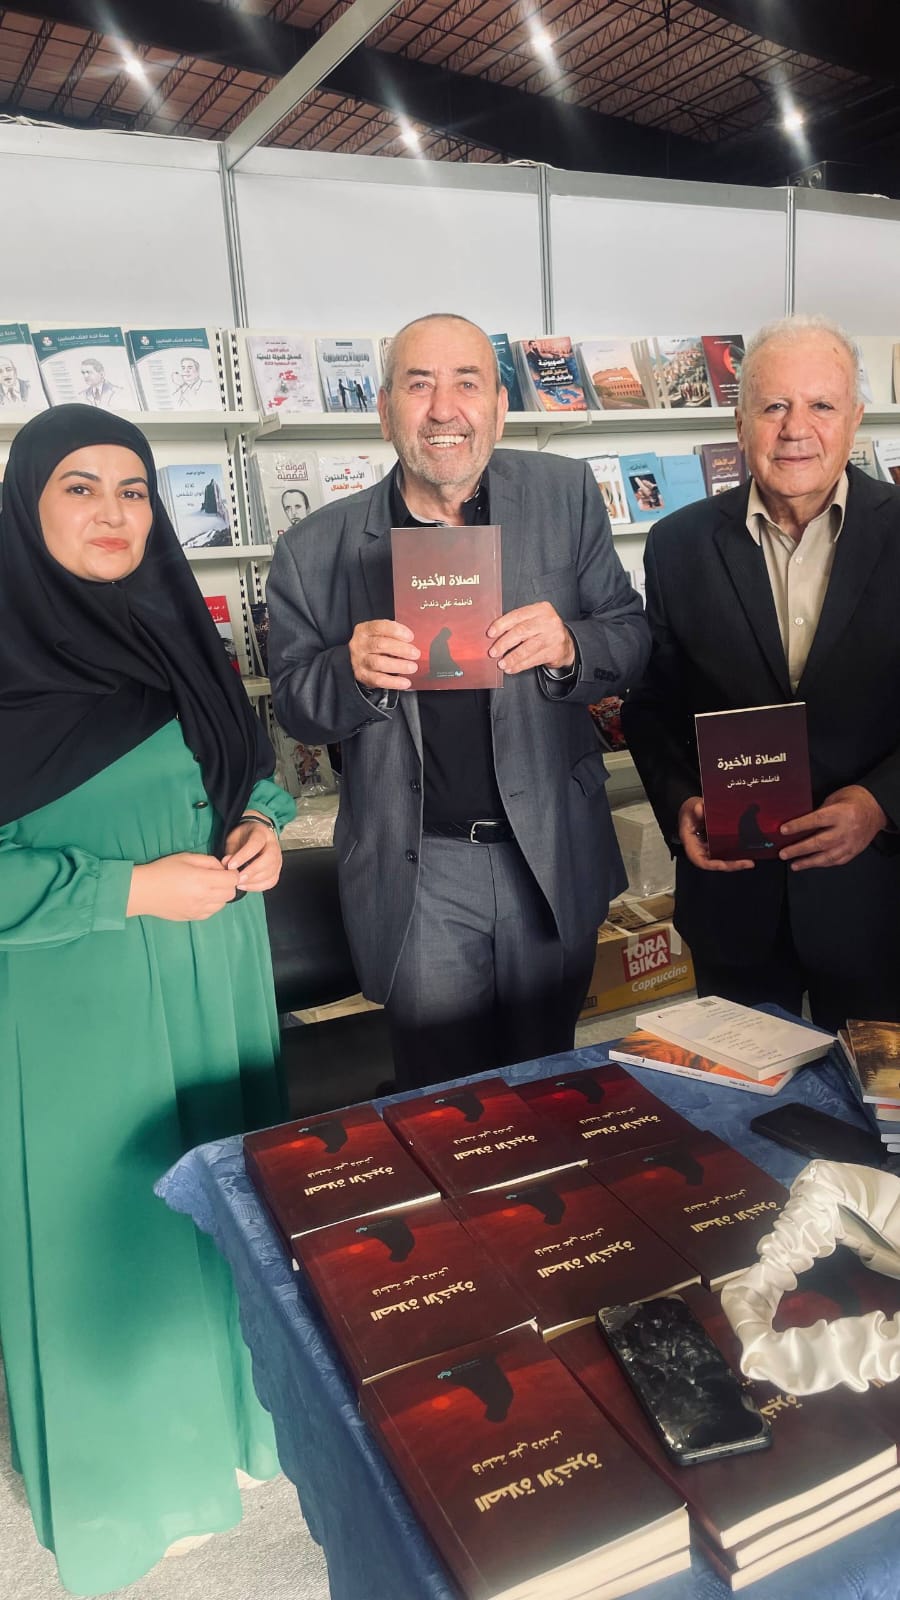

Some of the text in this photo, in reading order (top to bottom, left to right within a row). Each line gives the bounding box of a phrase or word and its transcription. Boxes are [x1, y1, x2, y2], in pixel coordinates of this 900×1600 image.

[411, 573, 480, 590] الصلاة الأخيرة
[420, 597, 473, 610] فاطمة علي دندش
[717, 753, 787, 770] الصلاة الأخيرة
[727, 775, 780, 789] فاطمة علي دندش
[623, 935, 668, 961] TORA
[629, 951, 668, 977] BIKA
[632, 964, 688, 993] Cappuccino
[581, 1115, 662, 1140] الصلاة الأخيرة
[454, 1134, 538, 1161] الصلاة الأخيرة
[304, 1166, 394, 1196] الصلاة الأخيرة
[690, 1201, 781, 1233] الصلاة الأخيرة
[534, 1227, 605, 1257] فاطمة علي دندش
[537, 1240, 636, 1279] الصلاة الأخيرة
[372, 1266, 449, 1297] فاطمة علي دندش
[370, 1281, 477, 1322] الصلاة الأخيرة
[472, 1430, 563, 1475] فاطمة علي دندش
[474, 1452, 603, 1513] الصلاة الأخيرة
